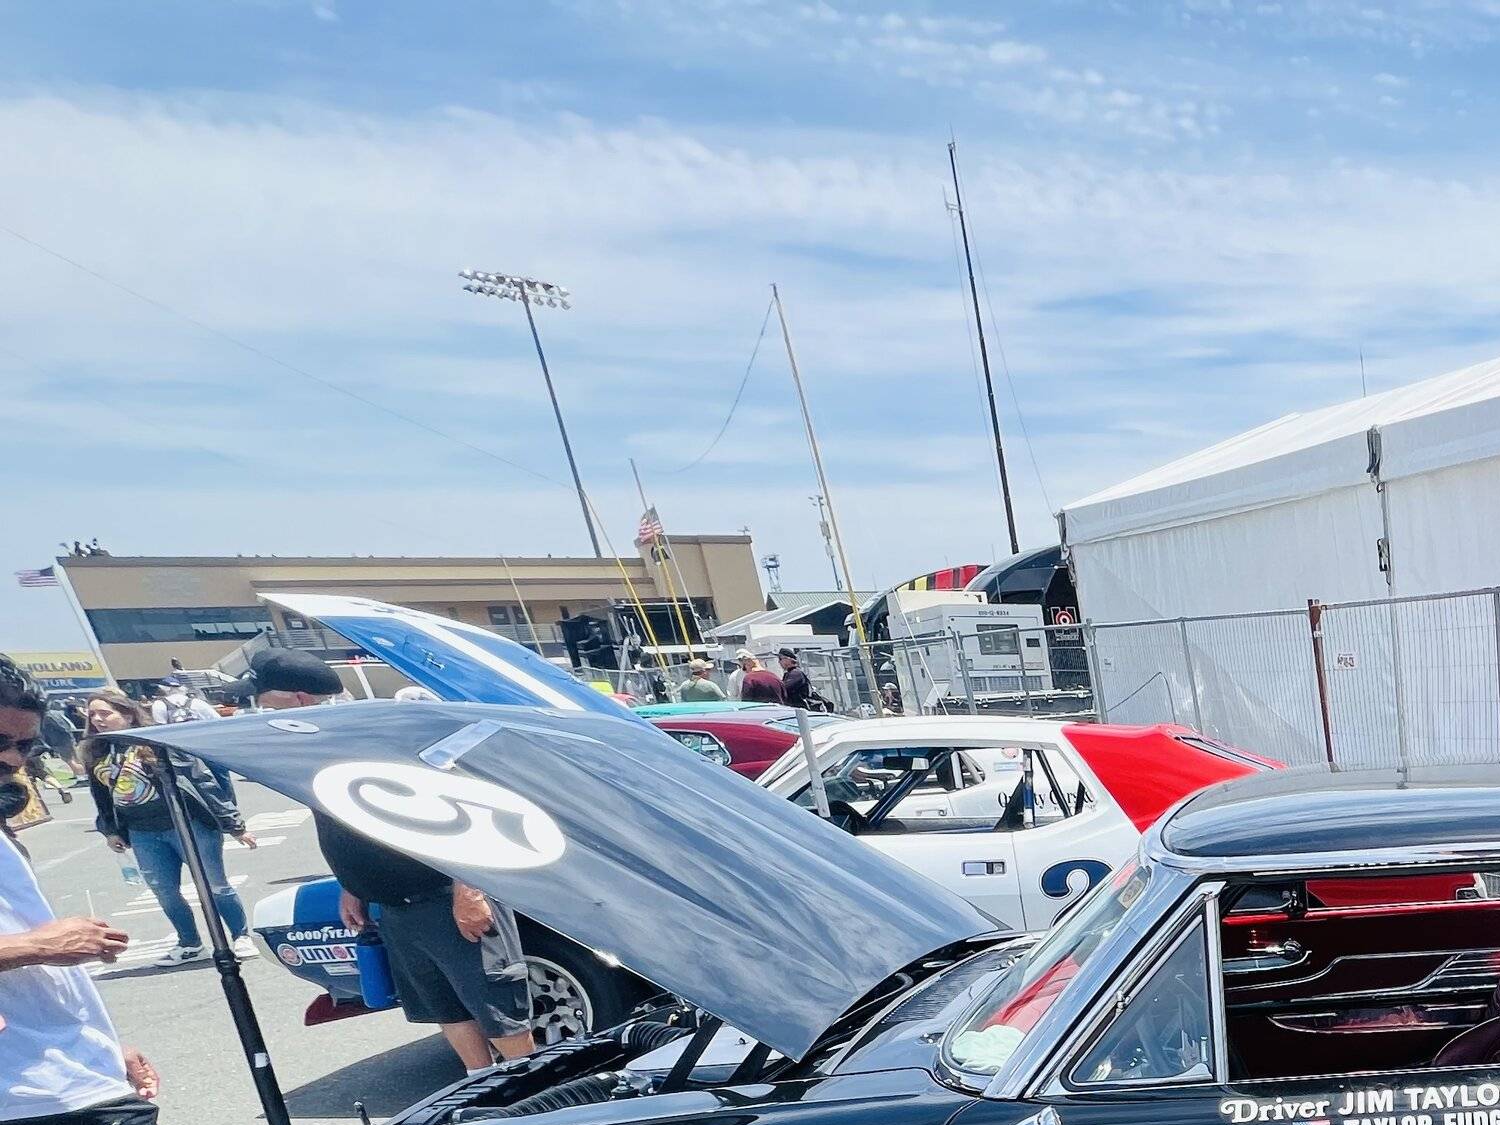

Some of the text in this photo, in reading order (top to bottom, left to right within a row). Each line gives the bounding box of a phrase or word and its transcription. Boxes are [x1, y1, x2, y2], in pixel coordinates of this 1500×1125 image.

[347, 776, 540, 853] 5
[1220, 1097, 1331, 1124] Driver
[1338, 1089, 1393, 1116] JIM
